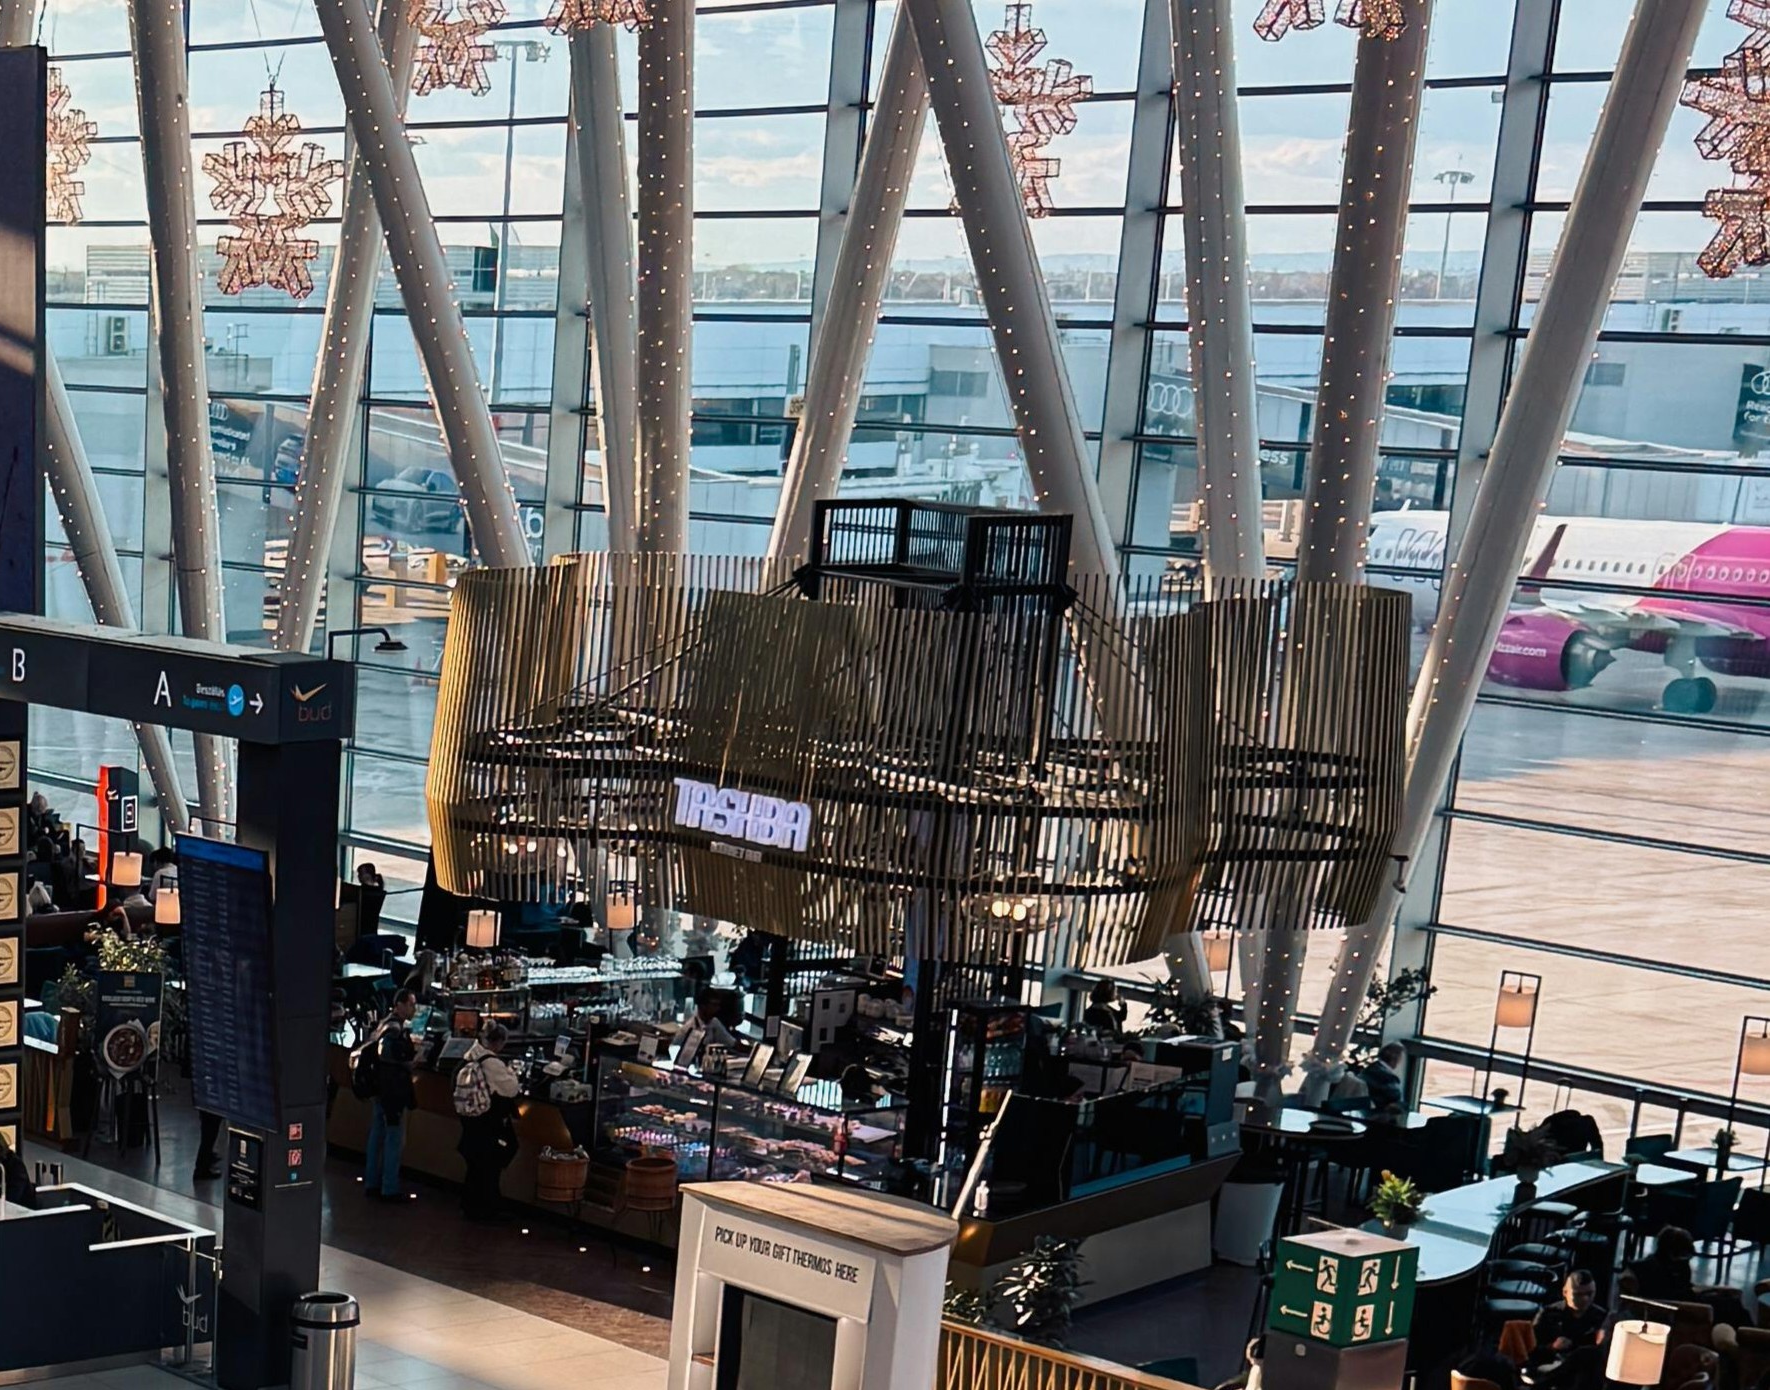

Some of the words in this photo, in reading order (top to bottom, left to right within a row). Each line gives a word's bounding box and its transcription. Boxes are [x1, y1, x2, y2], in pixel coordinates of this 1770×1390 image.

[12, 648, 26, 682] B
[153, 670, 172, 707] A
[714, 1226, 734, 1245] PICK
[735, 1232, 747, 1249] UP
[749, 1236, 770, 1257] YOUR
[772, 1243, 792, 1263] GIFT
[792, 1249, 833, 1276] THERMOS
[835, 1262, 859, 1283] HERE
